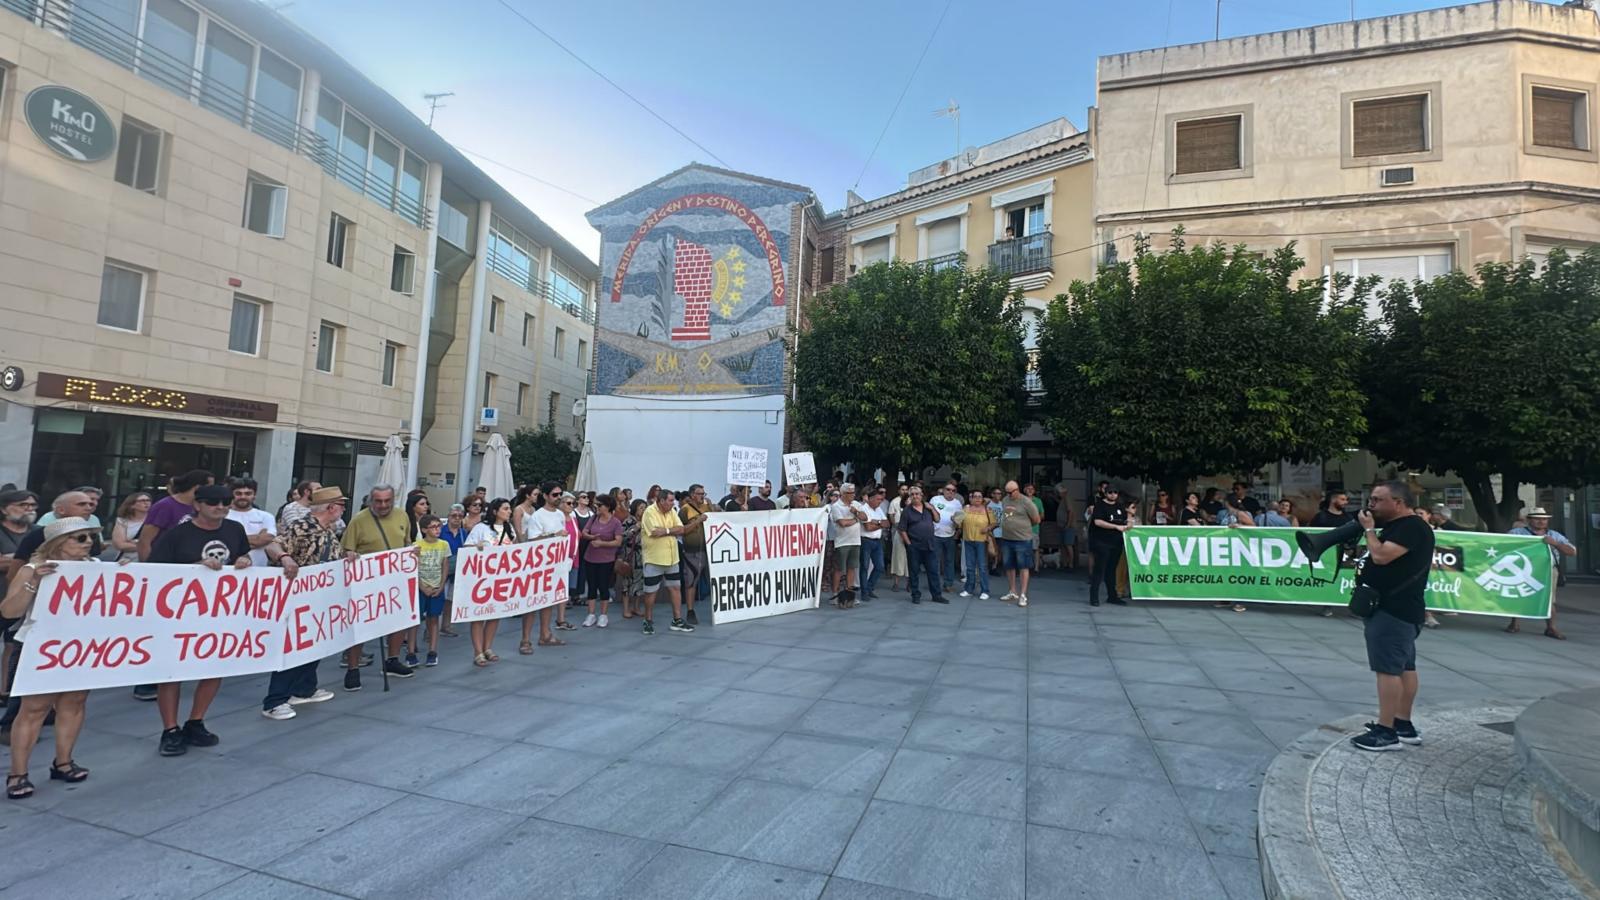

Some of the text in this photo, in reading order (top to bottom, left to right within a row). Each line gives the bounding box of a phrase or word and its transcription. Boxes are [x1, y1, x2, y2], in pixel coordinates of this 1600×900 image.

[50, 121, 92, 145] HOSTEL
[638, 200, 683, 234] ORIGEN
[685, 197, 694, 208] Y
[695, 196, 748, 217] DESTINO
[747, 216, 785, 298] PEREGRINO
[789, 457, 799, 468] NO
[743, 523, 823, 561] LA VIVIENDA:
[292, 569, 334, 595] ONDOS
[343, 550, 418, 587] BUITRES
[472, 567, 554, 604] GENTE
[1156, 574, 1169, 584] SE
[1172, 574, 1224, 585] ESPECULA
[1228, 575, 1256, 586] CON
[1260, 576, 1271, 586] EL
[1486, 580, 1537, 598] PCE
[156, 574, 294, 622] CARMEN
[711, 570, 771, 613] DERECHO
[454, 606, 469, 621] NI
[501, 600, 520, 613] SIN
[36, 629, 270, 671] SOMOS TODAS
